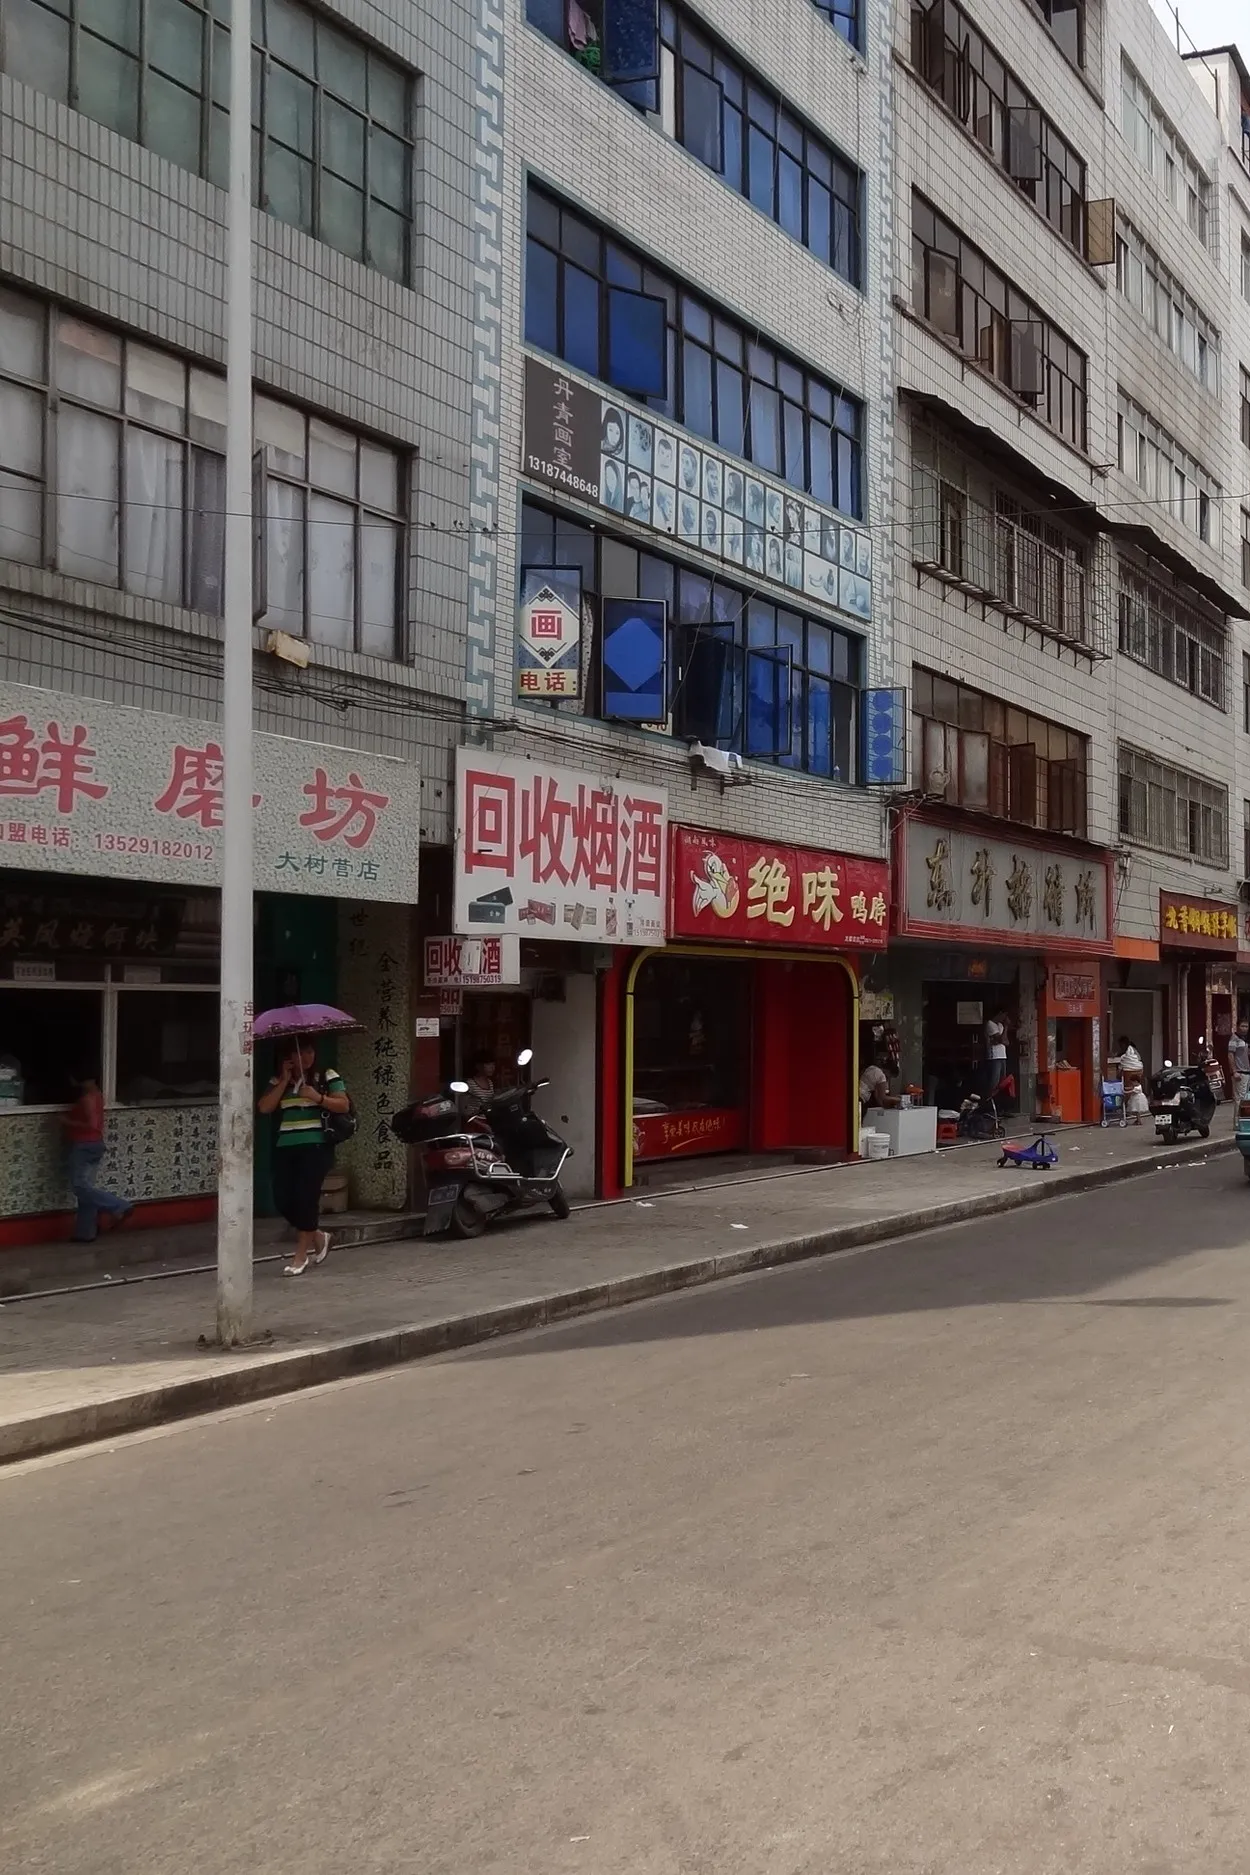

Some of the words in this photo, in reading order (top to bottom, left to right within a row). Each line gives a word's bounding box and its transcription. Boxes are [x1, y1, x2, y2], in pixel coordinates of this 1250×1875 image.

[552, 376, 574, 472] 丹青画室
[528, 455, 599, 498] 13187448648
[531, 609, 562, 640] 画
[0, 714, 390, 850] 鲜磨坊
[94, 833, 214, 861] 13529182012
[464, 769, 663, 898] 回收烟酒
[274, 852, 381, 881] 大树营店
[746, 856, 845, 932] 绝味
[850, 891, 887, 926] 鸭脖
[427, 937, 501, 976] 回收酒
